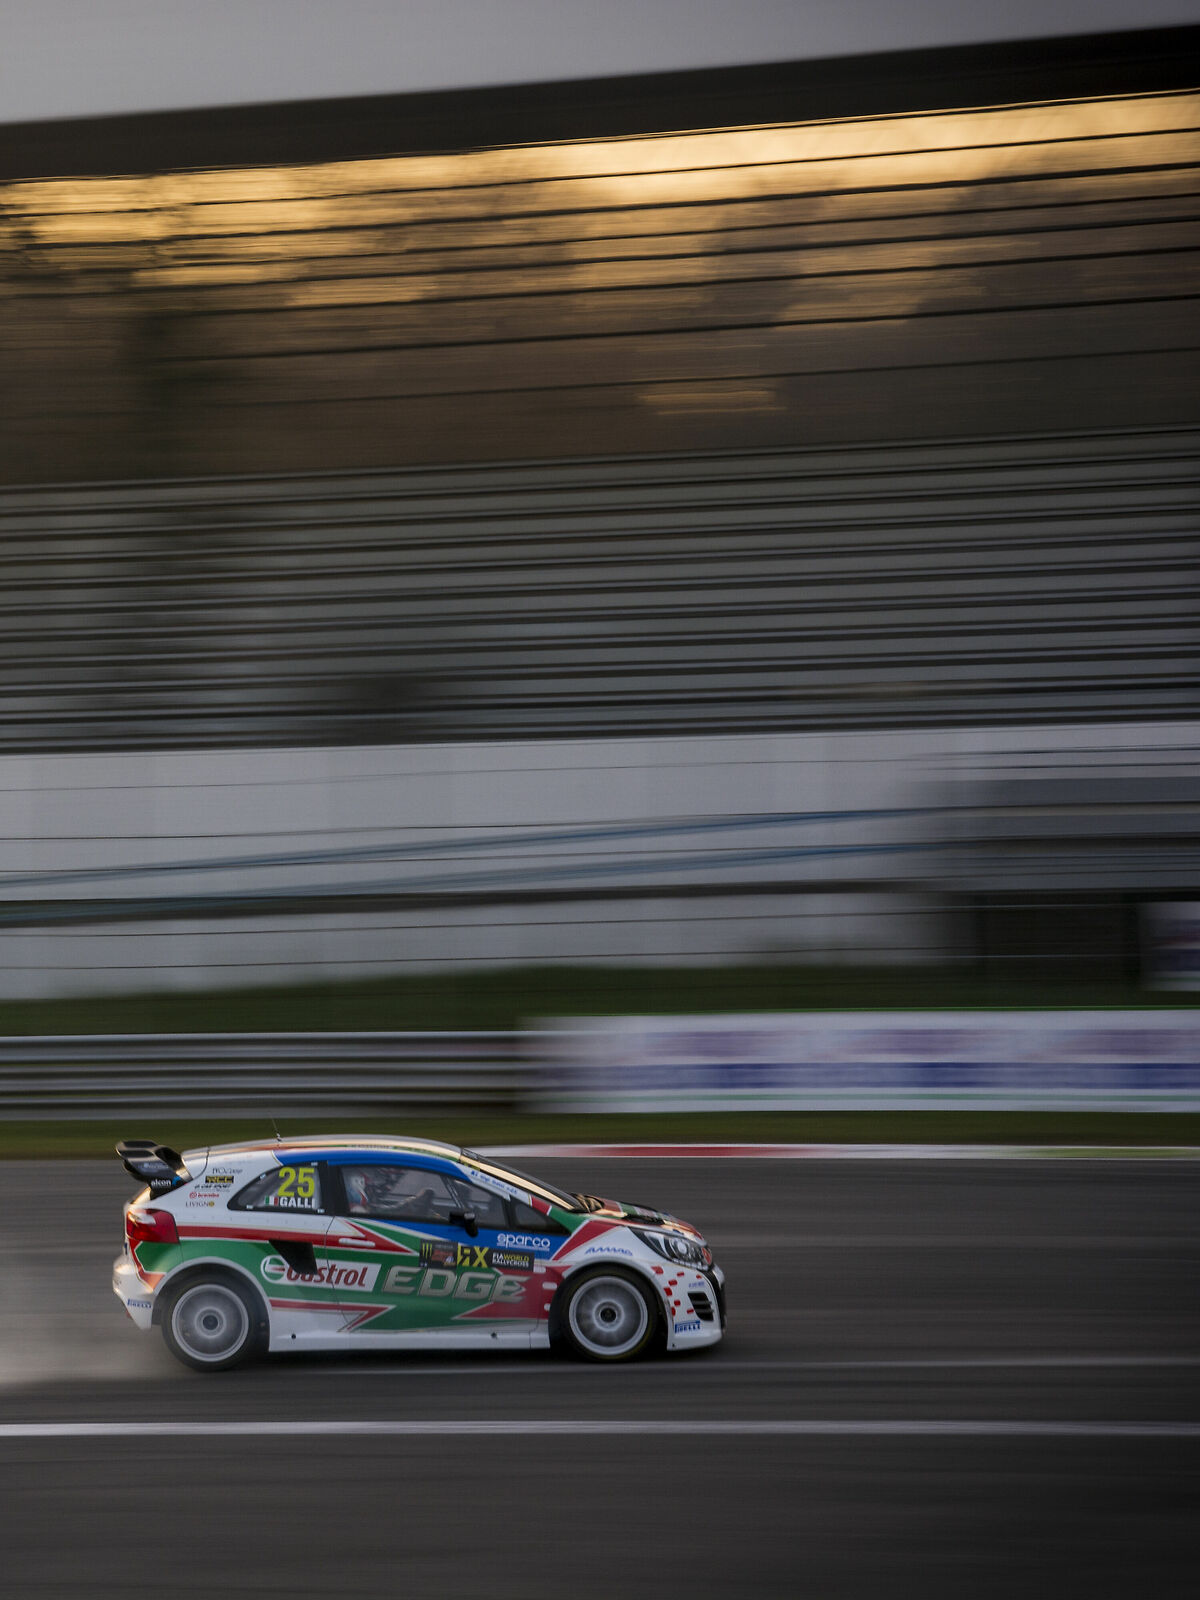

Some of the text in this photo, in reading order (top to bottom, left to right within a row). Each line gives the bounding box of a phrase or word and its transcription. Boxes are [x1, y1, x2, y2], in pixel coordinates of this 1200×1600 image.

[277, 1167, 315, 1197] 25
[280, 1197, 315, 1209] GALLI
[497, 1233, 550, 1249] sparco
[382, 1266, 531, 1302] EDGE
